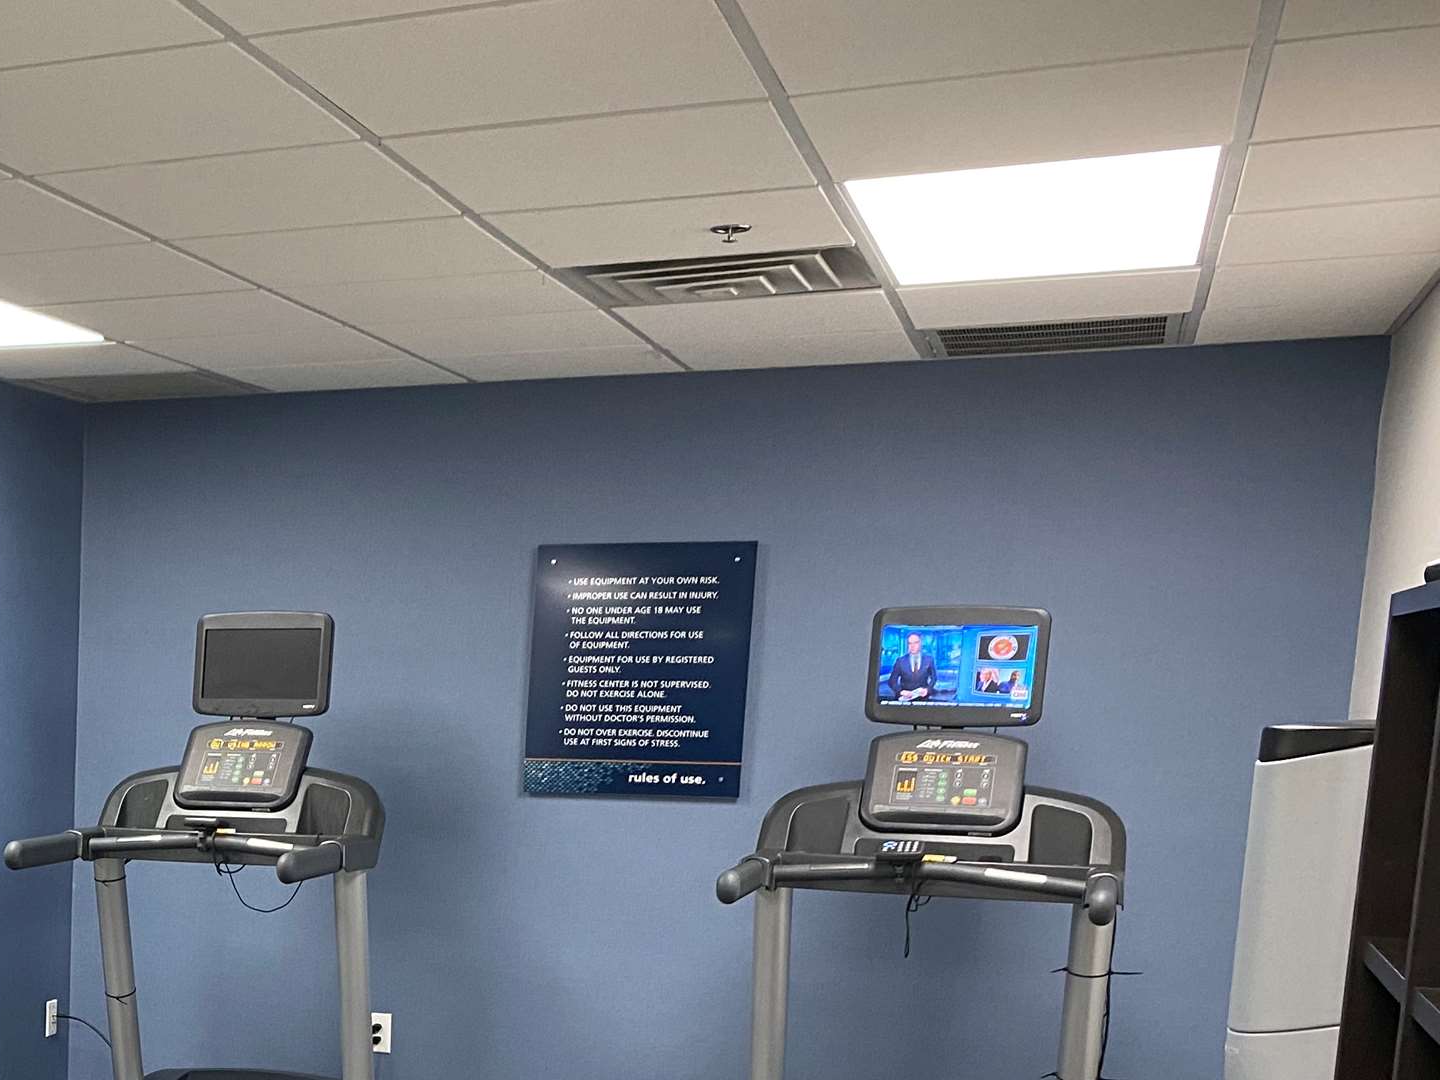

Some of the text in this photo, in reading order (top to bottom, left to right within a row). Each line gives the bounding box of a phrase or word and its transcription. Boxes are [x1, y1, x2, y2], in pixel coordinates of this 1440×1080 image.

[590, 577, 637, 586] EQUIPMENT
[652, 577, 674, 585] YOUR
[572, 592, 612, 600] IMPROPER
[614, 592, 628, 600] USE
[570, 631, 604, 639] FOLLOW
[621, 631, 668, 639] DIRECTIONS
[670, 631, 686, 639] FOR
[569, 656, 615, 664] EQUIPMENT
[665, 656, 714, 664] REGISTERED
[600, 690, 635, 698] EXERCISE
[634, 705, 682, 713] EQUIPMENT
[565, 714, 602, 722] WITHOUT
[657, 730, 709, 738] DISCONTINUE
[651, 739, 680, 747] STRESS.
[628, 773, 659, 783] rules
[663, 773, 677, 784] of
